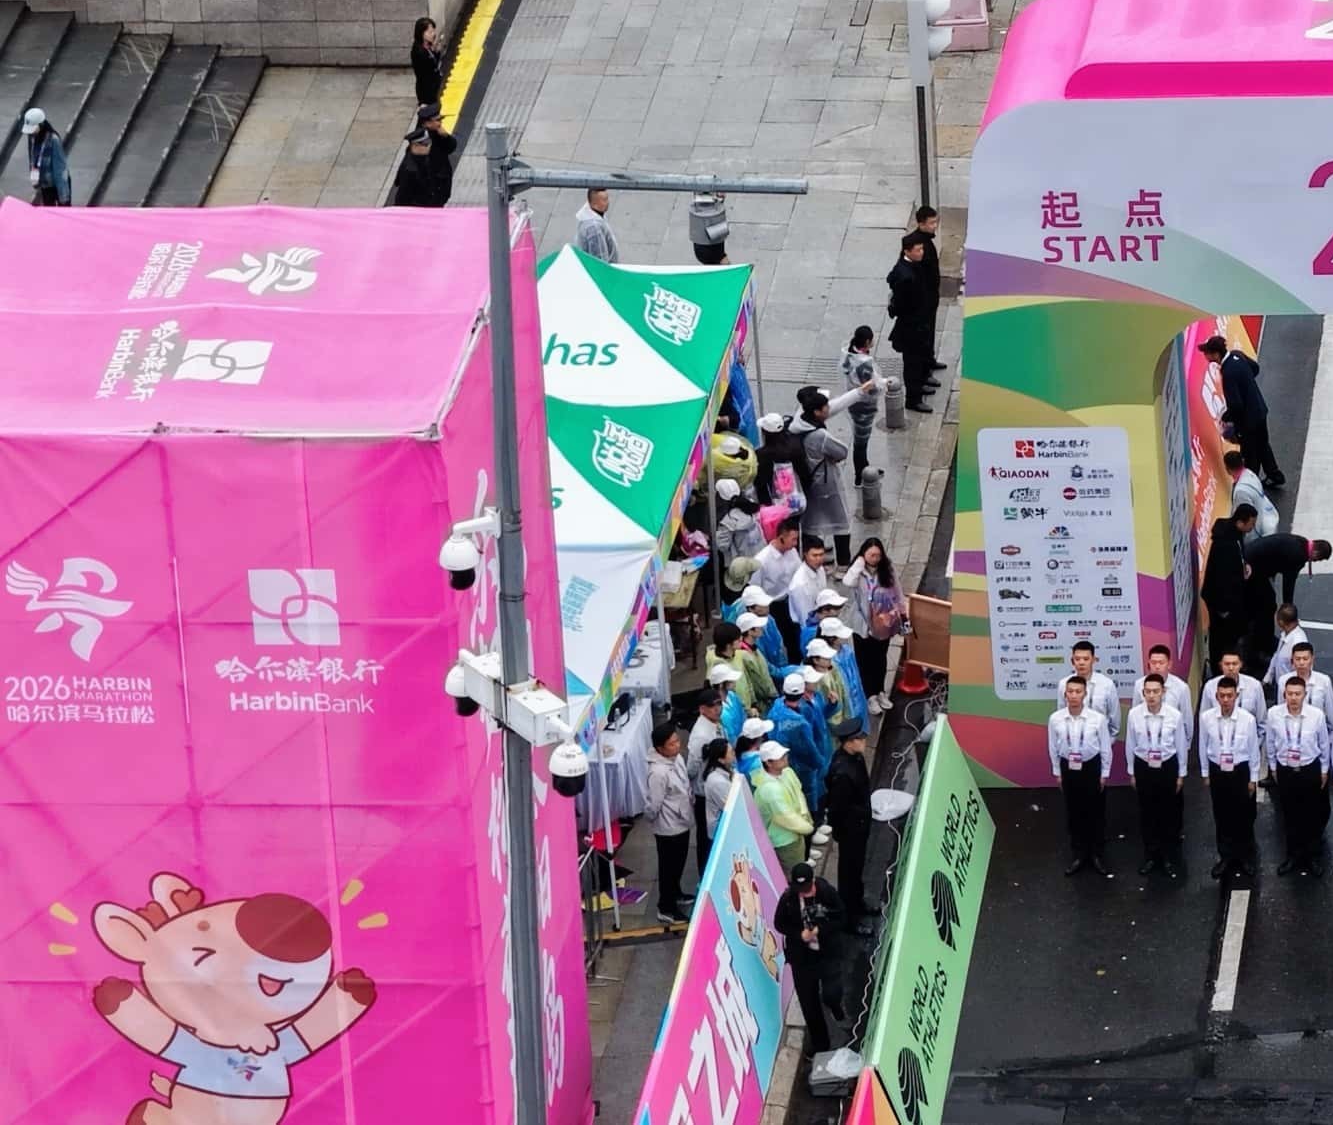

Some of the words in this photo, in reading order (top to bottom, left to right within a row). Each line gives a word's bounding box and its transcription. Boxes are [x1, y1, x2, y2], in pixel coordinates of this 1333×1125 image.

[1041, 189, 1165, 229] 起点
[1043, 235, 1165, 264] START
[95, 329, 142, 399] HarbinBank
[999, 469, 1049, 479] QIAODAN
[1020, 506, 1048, 520] 蒙牛
[73, 676, 152, 691] HARBIN
[215, 656, 385, 685] 哈尔滨银行
[4, 675, 71, 702] 2026
[73, 691, 153, 702] MARATHON
[230, 691, 374, 714] HarbinBank
[6, 704, 155, 724] 哈尔滨马拉松
[940, 793, 962, 866] WORLD
[952, 790, 981, 897] ATHLETICS
[908, 964, 929, 1042] WORLD
[920, 961, 948, 1074] ATHLETICS
